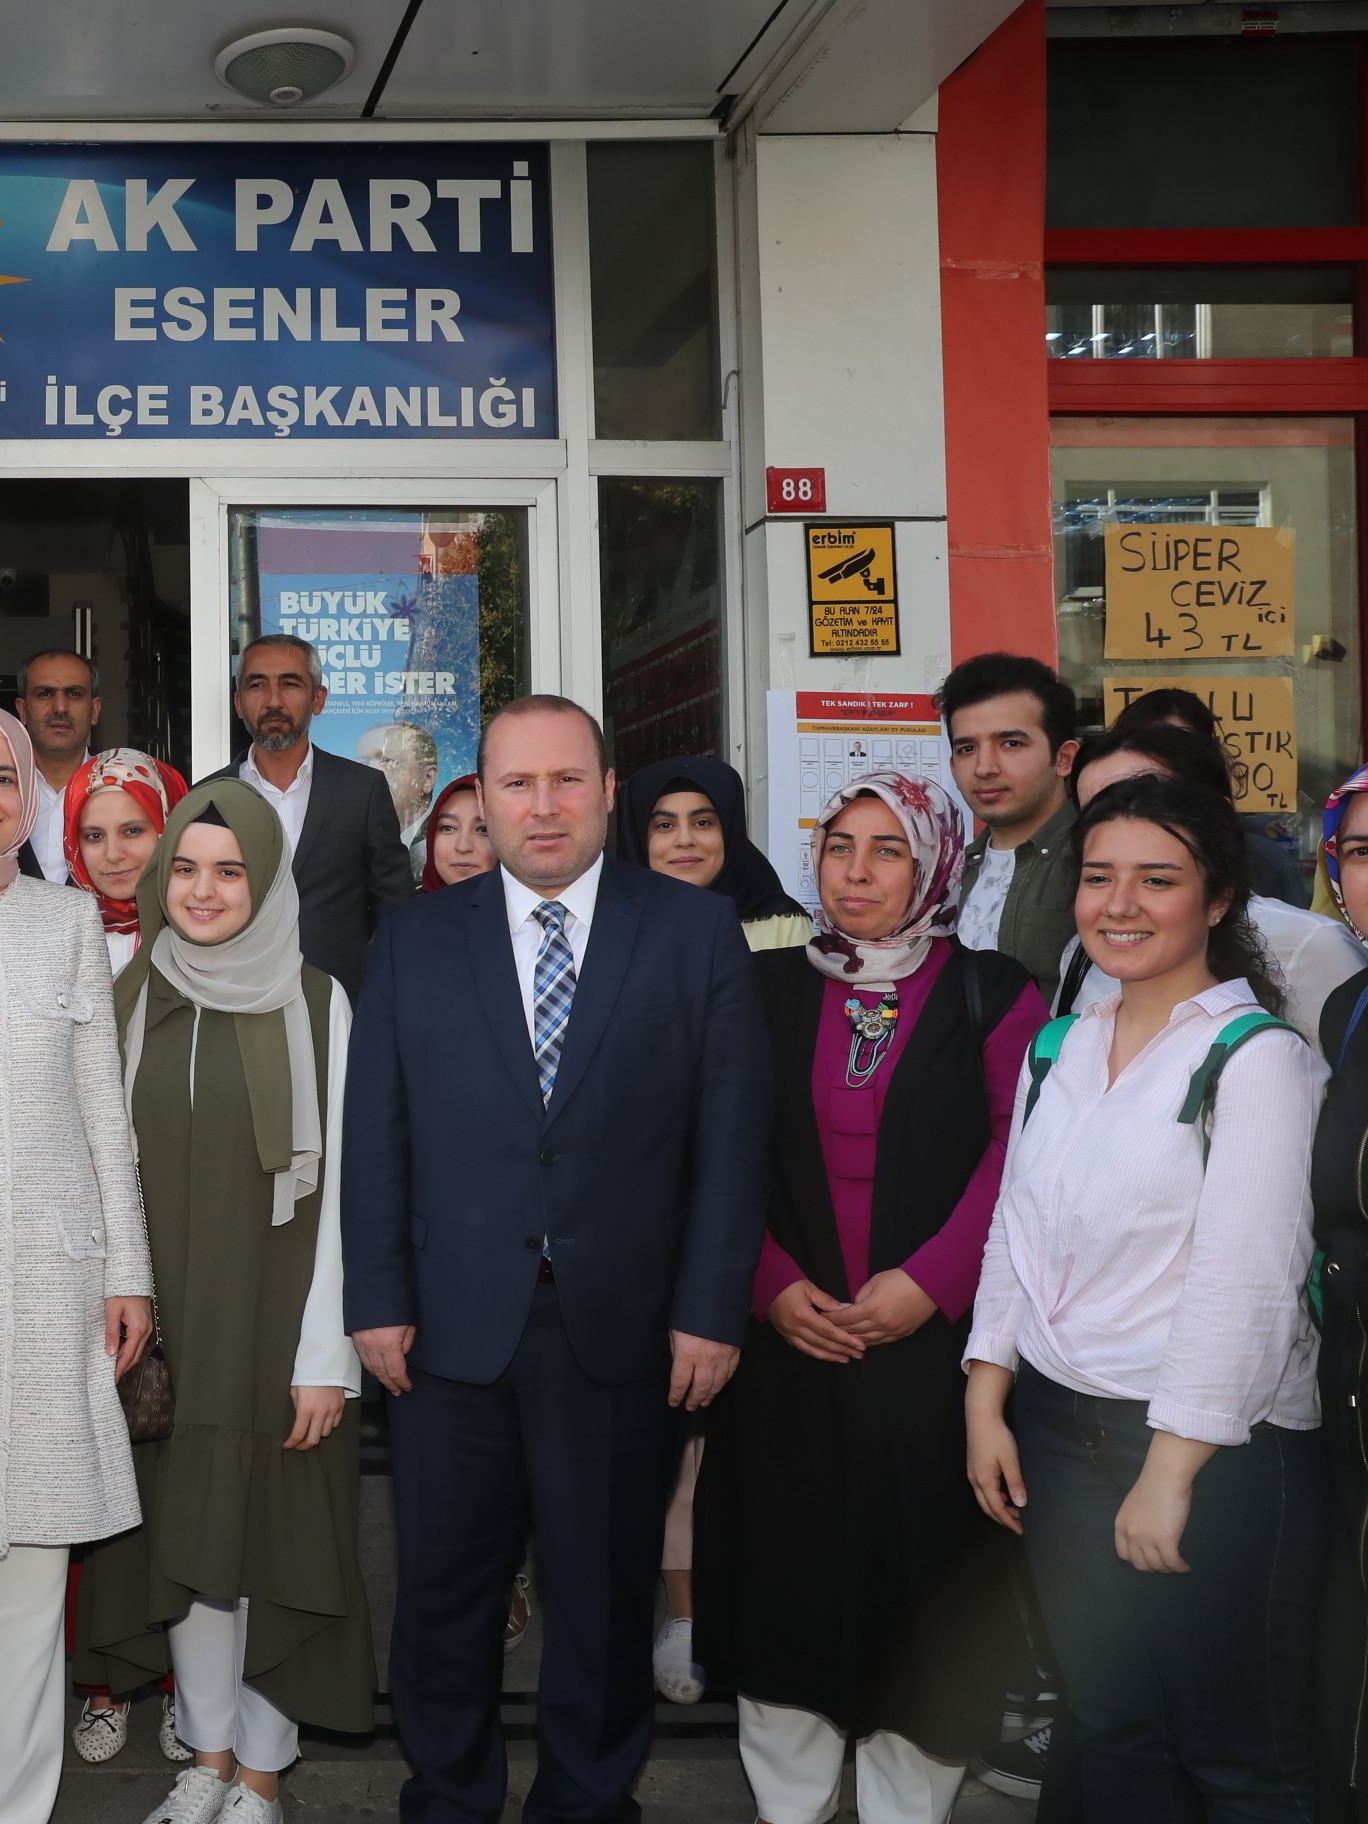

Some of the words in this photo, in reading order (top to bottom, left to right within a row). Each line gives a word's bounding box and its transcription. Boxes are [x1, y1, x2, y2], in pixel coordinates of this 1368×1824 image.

[46, 178, 197, 252] AK
[235, 161, 534, 253] PARTİ
[114, 287, 465, 342] ESENLER
[45, 375, 169, 436] İLÇE
[190, 377, 535, 437] BAŞKANLIĞI
[782, 478, 812, 501] 88
[812, 530, 856, 545] erbim
[1120, 531, 1241, 573] SÜPER
[280, 591, 389, 614] BÜYÜK
[824, 606, 836, 615] BU
[839, 606, 860, 615] ALAN
[865, 606, 883, 615] 7/24
[279, 618, 410, 641] TÜRKİYE
[814, 616, 854, 627] GÖZETİM
[872, 616, 894, 626] KAYIT
[1145, 612, 1203, 651] 43
[1221, 633, 1262, 651] TL
[831, 629, 878, 638] ALTINDADIR
[375, 671, 457, 695] İSTER
[838, 700, 866, 708] SANDIK
[1113, 687, 1253, 721] TLU
[1267, 792, 1288, 809] TL
